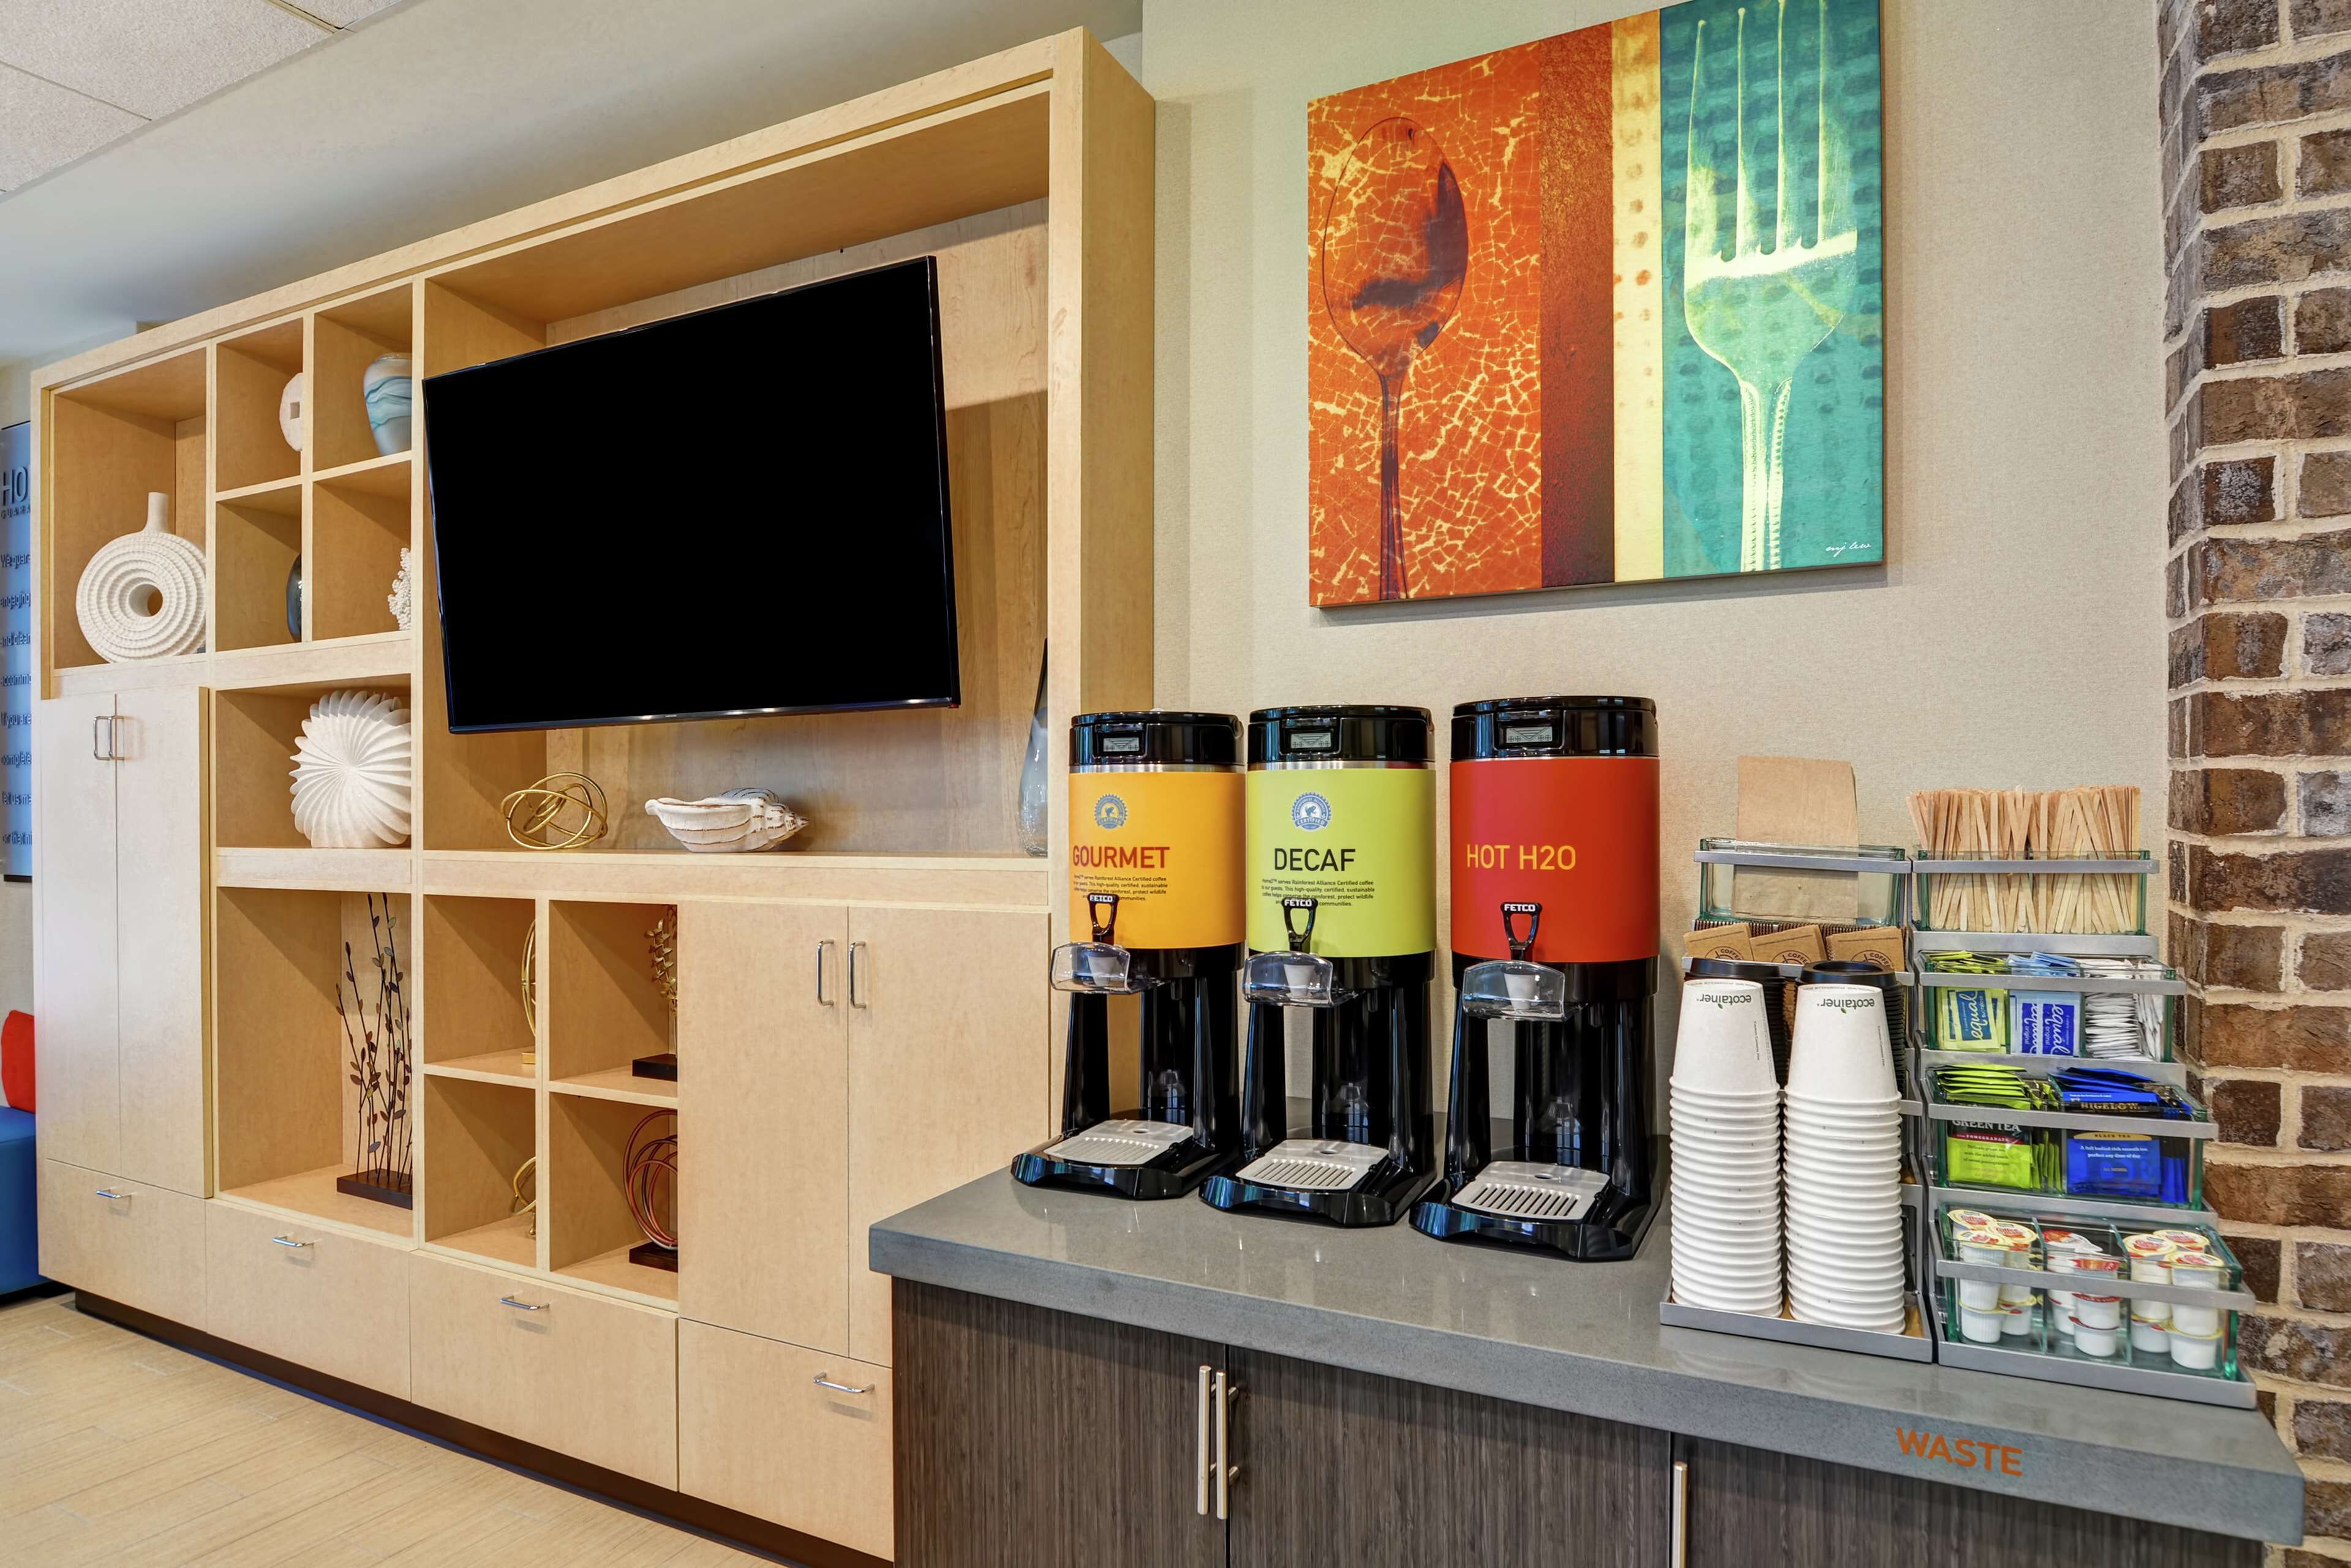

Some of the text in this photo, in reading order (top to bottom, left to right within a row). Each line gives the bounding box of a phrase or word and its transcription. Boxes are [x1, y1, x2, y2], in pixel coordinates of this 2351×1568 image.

[1073, 845, 1170, 868] GOURMET
[1274, 848, 1356, 871] DECAF
[1467, 844, 1576, 871] HOT H2O
[1284, 898, 1312, 907] FETCO
[1959, 991, 1988, 1040] equal
[2045, 1004, 2071, 1054] equal
[1952, 1120, 2022, 1133] GREEN TEA
[1896, 1426, 2023, 1477] WASTE
